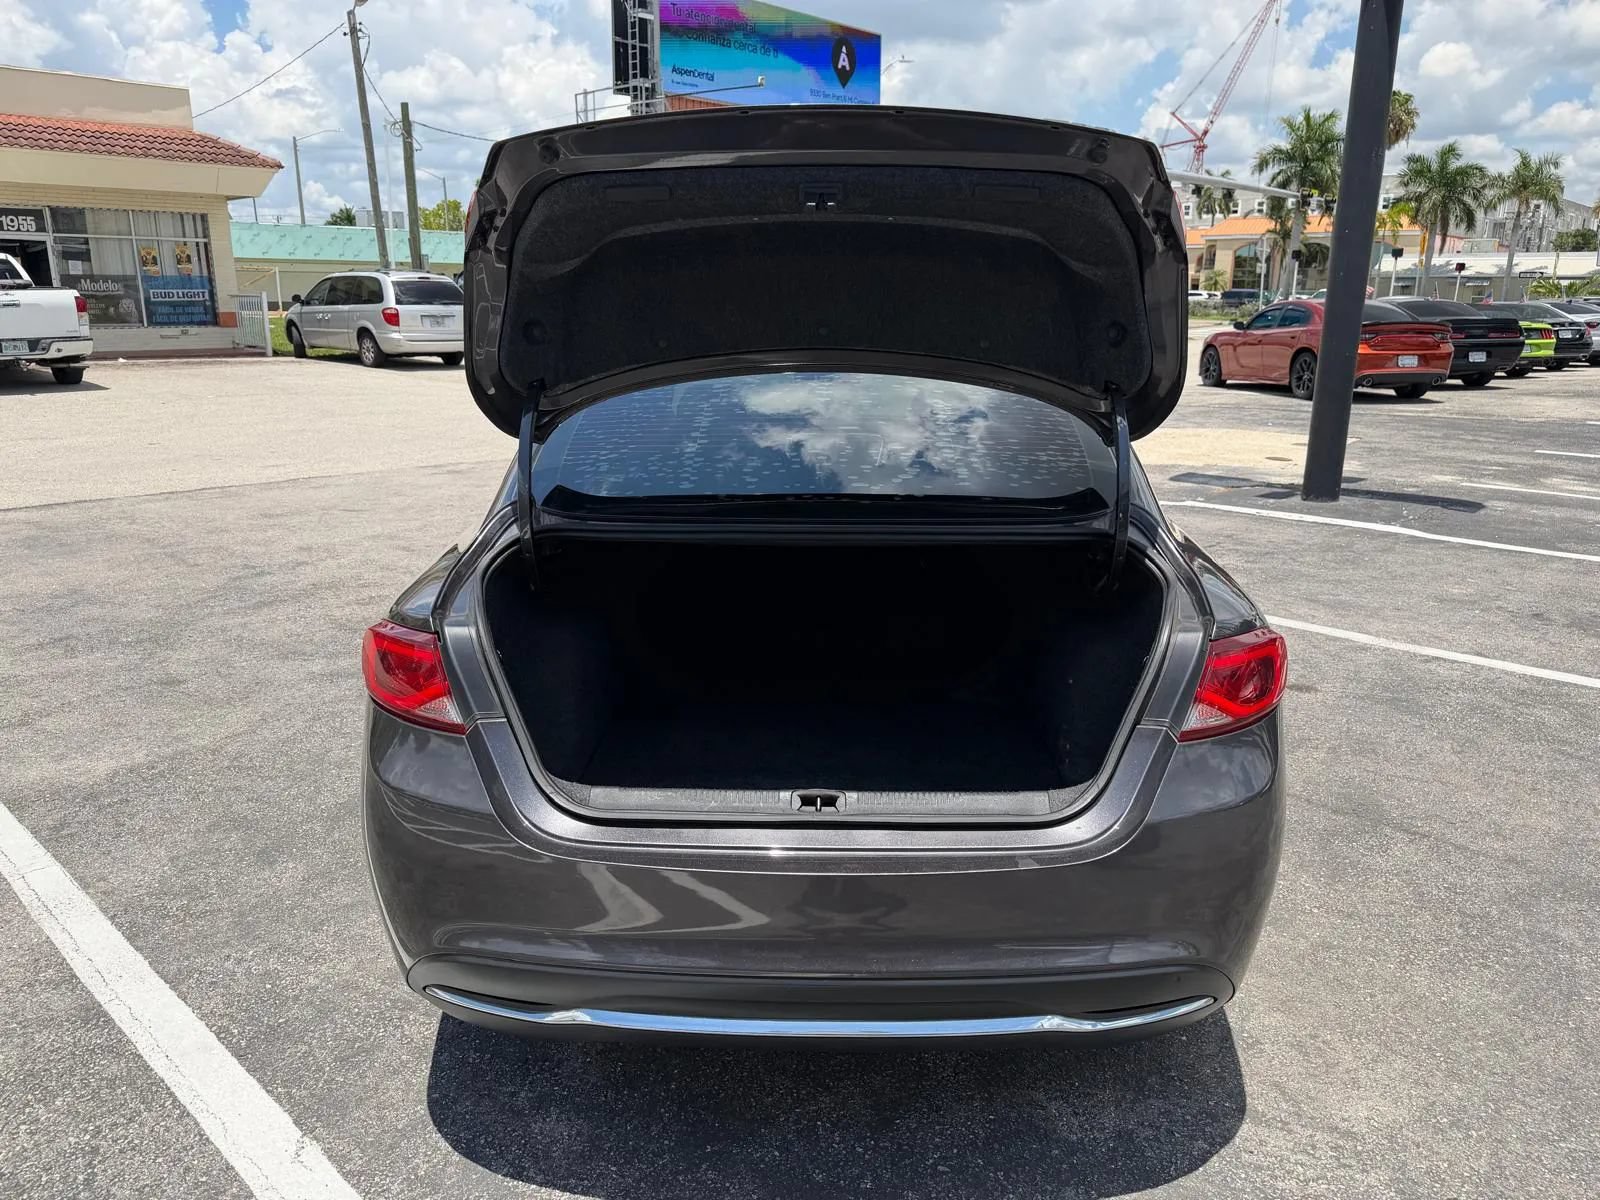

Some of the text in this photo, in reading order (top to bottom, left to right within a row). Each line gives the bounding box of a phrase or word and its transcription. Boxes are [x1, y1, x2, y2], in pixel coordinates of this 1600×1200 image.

[670, 2, 682, 17] Tu
[733, 38, 758, 54] cerca
[760, 44, 771, 57] de
[0, 215, 36, 231] 1955
[80, 278, 118, 291] Modelo
[152, 291, 207, 299] BUD LIGHT
